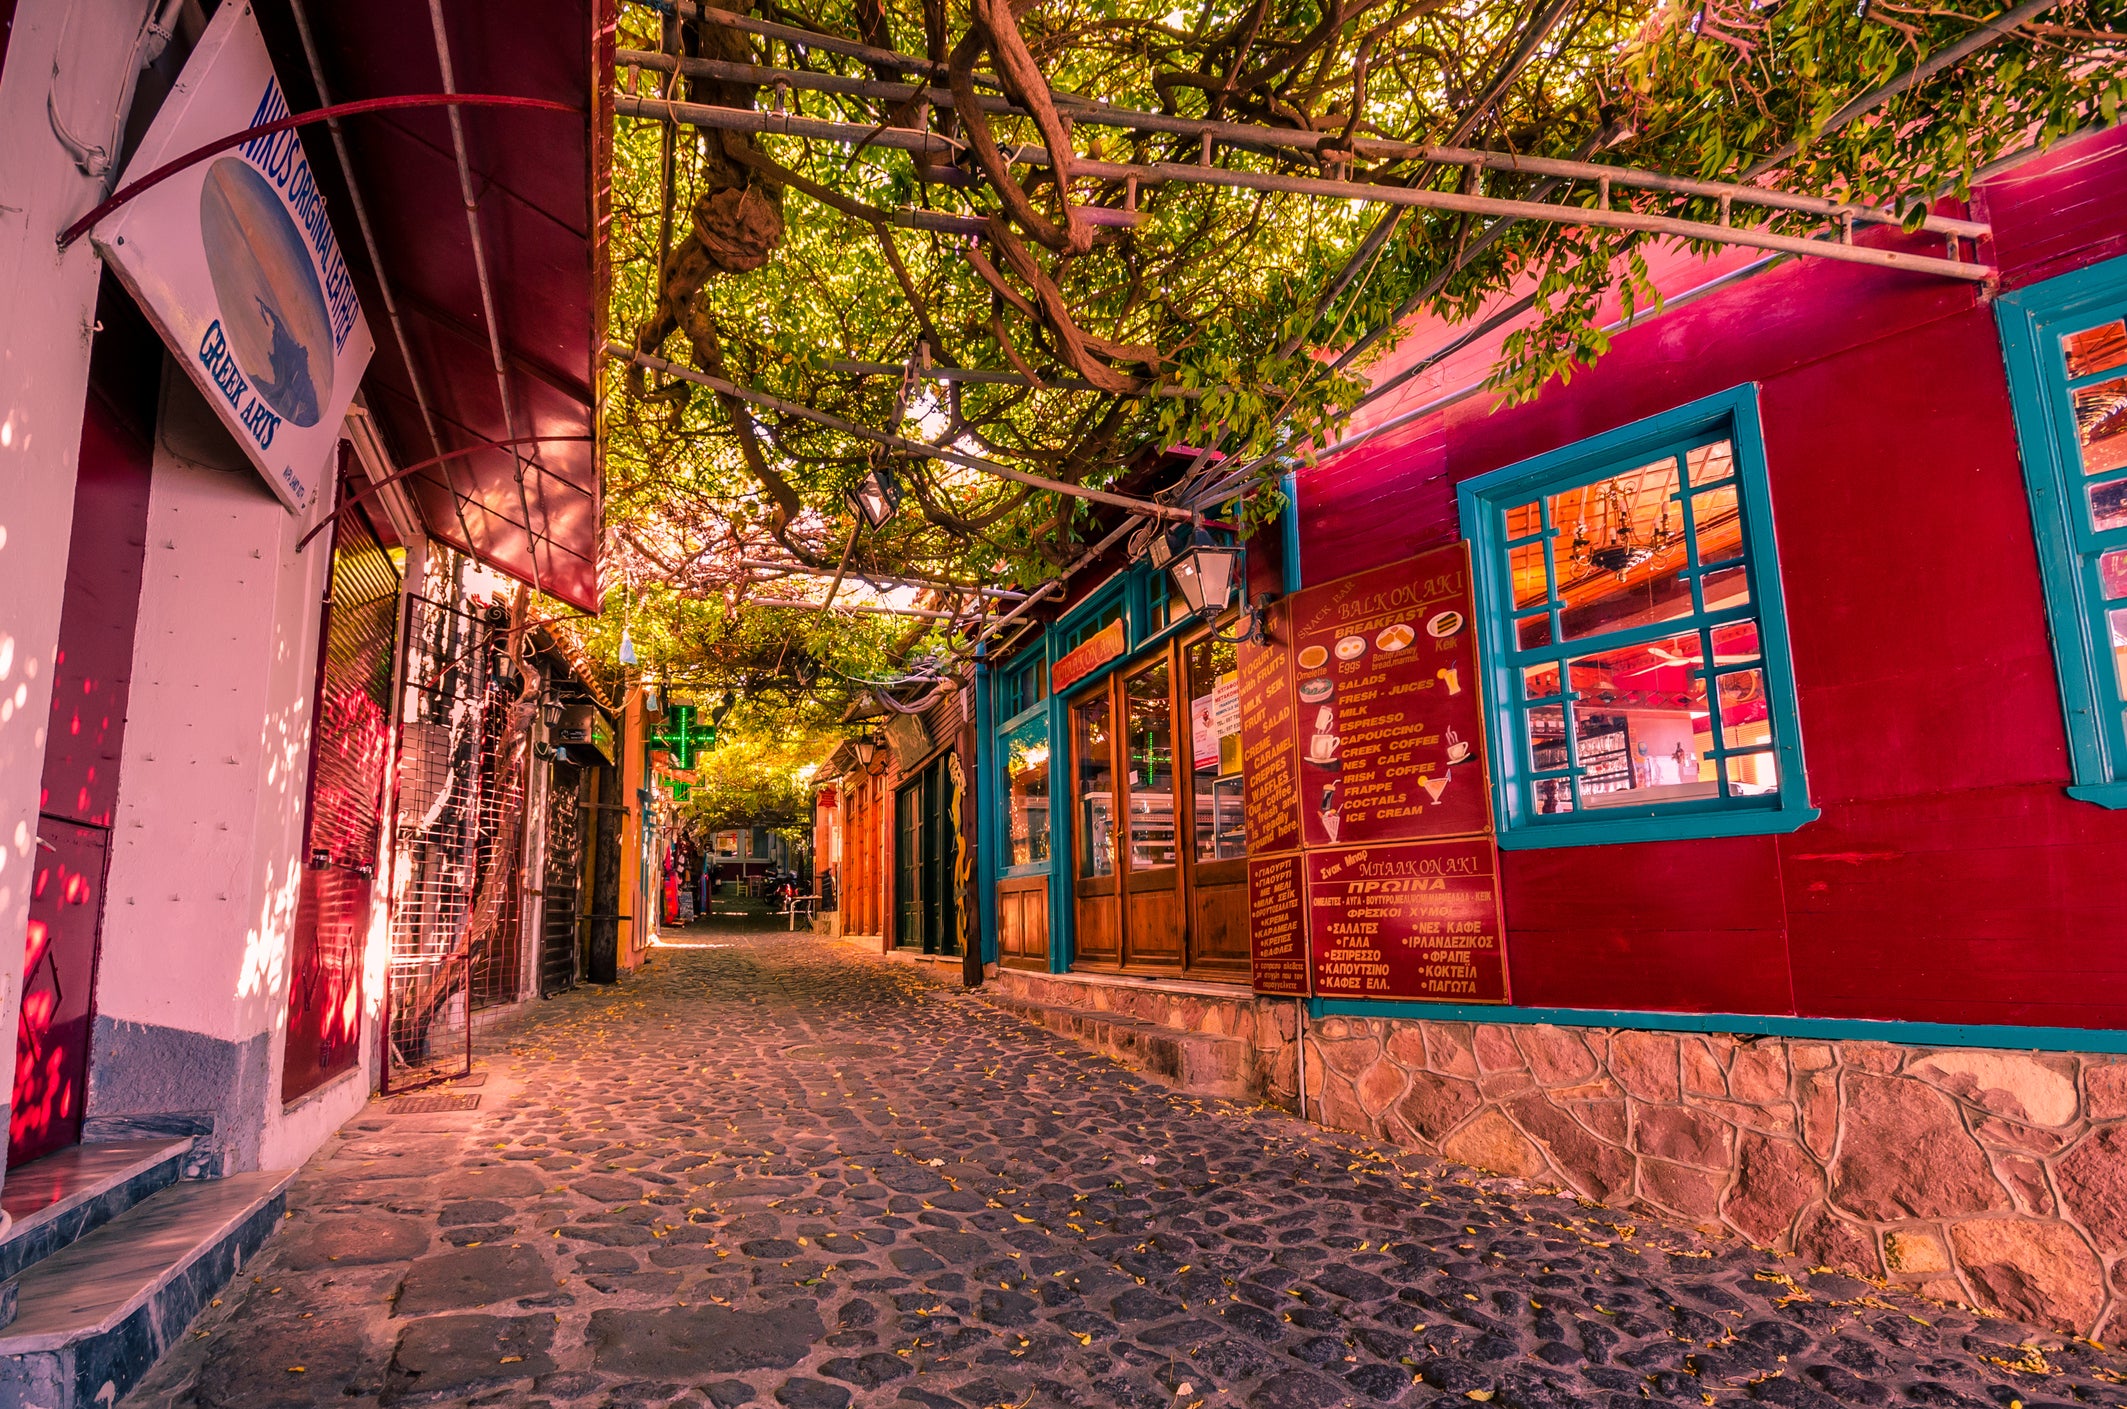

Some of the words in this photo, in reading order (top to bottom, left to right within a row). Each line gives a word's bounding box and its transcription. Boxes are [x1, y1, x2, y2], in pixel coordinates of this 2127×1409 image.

[288, 159, 335, 275] ORIGINAL
[325, 249, 360, 357] LEATHER
[199, 319, 248, 411] GREEK
[240, 396, 281, 450] ARTS
[1338, 570, 1463, 620] BALKONAKI
[1297, 604, 1332, 640] SNACK
[1332, 580, 1356, 603] BAR
[1335, 606, 1428, 639] BREAKFAST
[1435, 638, 1458, 651] Keik
[1242, 644, 1274, 678] YOGURT
[1338, 660, 1361, 675] Eggs
[1240, 679, 1256, 697] with
[1257, 653, 1286, 684] FRUITS
[1296, 668, 1328, 681] Omelette
[1338, 673, 1387, 692] SALADS
[1243, 692, 1262, 716] MILK
[1266, 675, 1285, 698] SEIK
[1338, 690, 1378, 706] FRESH
[1388, 679, 1435, 696] JUICES
[1244, 707, 1267, 732] FRUIT
[1262, 706, 1290, 734] SALAD
[1339, 705, 1368, 719] MILK
[1339, 712, 1404, 732] ESPRESSO
[1340, 723, 1424, 746] CAPOUCCINO
[1389, 734, 1440, 751] COFFEE
[1244, 735, 1272, 762] CREME
[1254, 737, 1294, 770] CARAMEL
[1342, 759, 1367, 771] NES
[1377, 752, 1412, 766] CAFE
[1249, 756, 1287, 788] CREPPES
[1343, 771, 1376, 784] IRISH
[1385, 762, 1437, 778] COFFEE
[1251, 771, 1289, 802] WAFFLES
[1344, 782, 1393, 797] FRAPPE
[1248, 803, 1262, 817] Our
[1266, 785, 1292, 806] coffee
[1343, 793, 1407, 810] COCTAILS
[1247, 819, 1254, 830] is
[1258, 804, 1278, 823] fresh
[1282, 791, 1297, 810] and
[1346, 812, 1367, 823] ICE
[1376, 805, 1423, 820] CREAM
[1251, 829, 1259, 840] is
[1262, 811, 1289, 834] readily
[1247, 830, 1275, 856] ground
[1258, 859, 1292, 878] ΓΙΑΟΥΡΤΙ
[1320, 863, 1342, 880] Σνακ
[1344, 850, 1368, 867] Μπαρ
[1359, 856, 1478, 877] ΜΠΑΛΚΟΝΑΚΙ
[1258, 870, 1292, 887] ΓΙΑΟΥΡΤΙ
[1348, 878, 1446, 894] ΠΡΩΙΝΑ
[1260, 887, 1271, 897] ΜΕ
[1273, 880, 1292, 893] ΜΕΛΙ
[1256, 896, 1274, 909] ΜΙΛΚ
[1313, 896, 1341, 906] ΟΜΕΛΕΤΕΣ
[1264, 912, 1289, 926] ΚΡΕΜΑ
[1419, 922, 1440, 933] ΝΕΣ
[1447, 921, 1481, 932] ΚΑΦΕ
[1257, 920, 1298, 938] ΚΑΡΑΜΕΛΕ
[1333, 923, 1379, 934] ΣΑΛΑΤΕΣ
[1264, 933, 1292, 947] ΚΡΕΠΕΣ
[1342, 937, 1370, 948] ΓΑΛΑ
[1409, 936, 1493, 948] ΙΡΛΑΝΔΕΖΙΚΟΣ
[1264, 943, 1293, 958] ΒΑΦΛΕΣ
[1331, 950, 1381, 961] ΕΣΠΡΕΣΣΟ
[1430, 951, 1471, 963] ΦΡΑΠΕ
[1325, 963, 1390, 975] ΚΑΠΟΥΤΣΙΝΟ
[1425, 963, 1477, 978] ΚΟΚΤΕΪΛ
[1326, 977, 1361, 988] ΚΑΦΕΣ
[1366, 978, 1390, 989] ΕΛΛ.
[1429, 980, 1476, 993] ΠΑΓΩΤΑ
